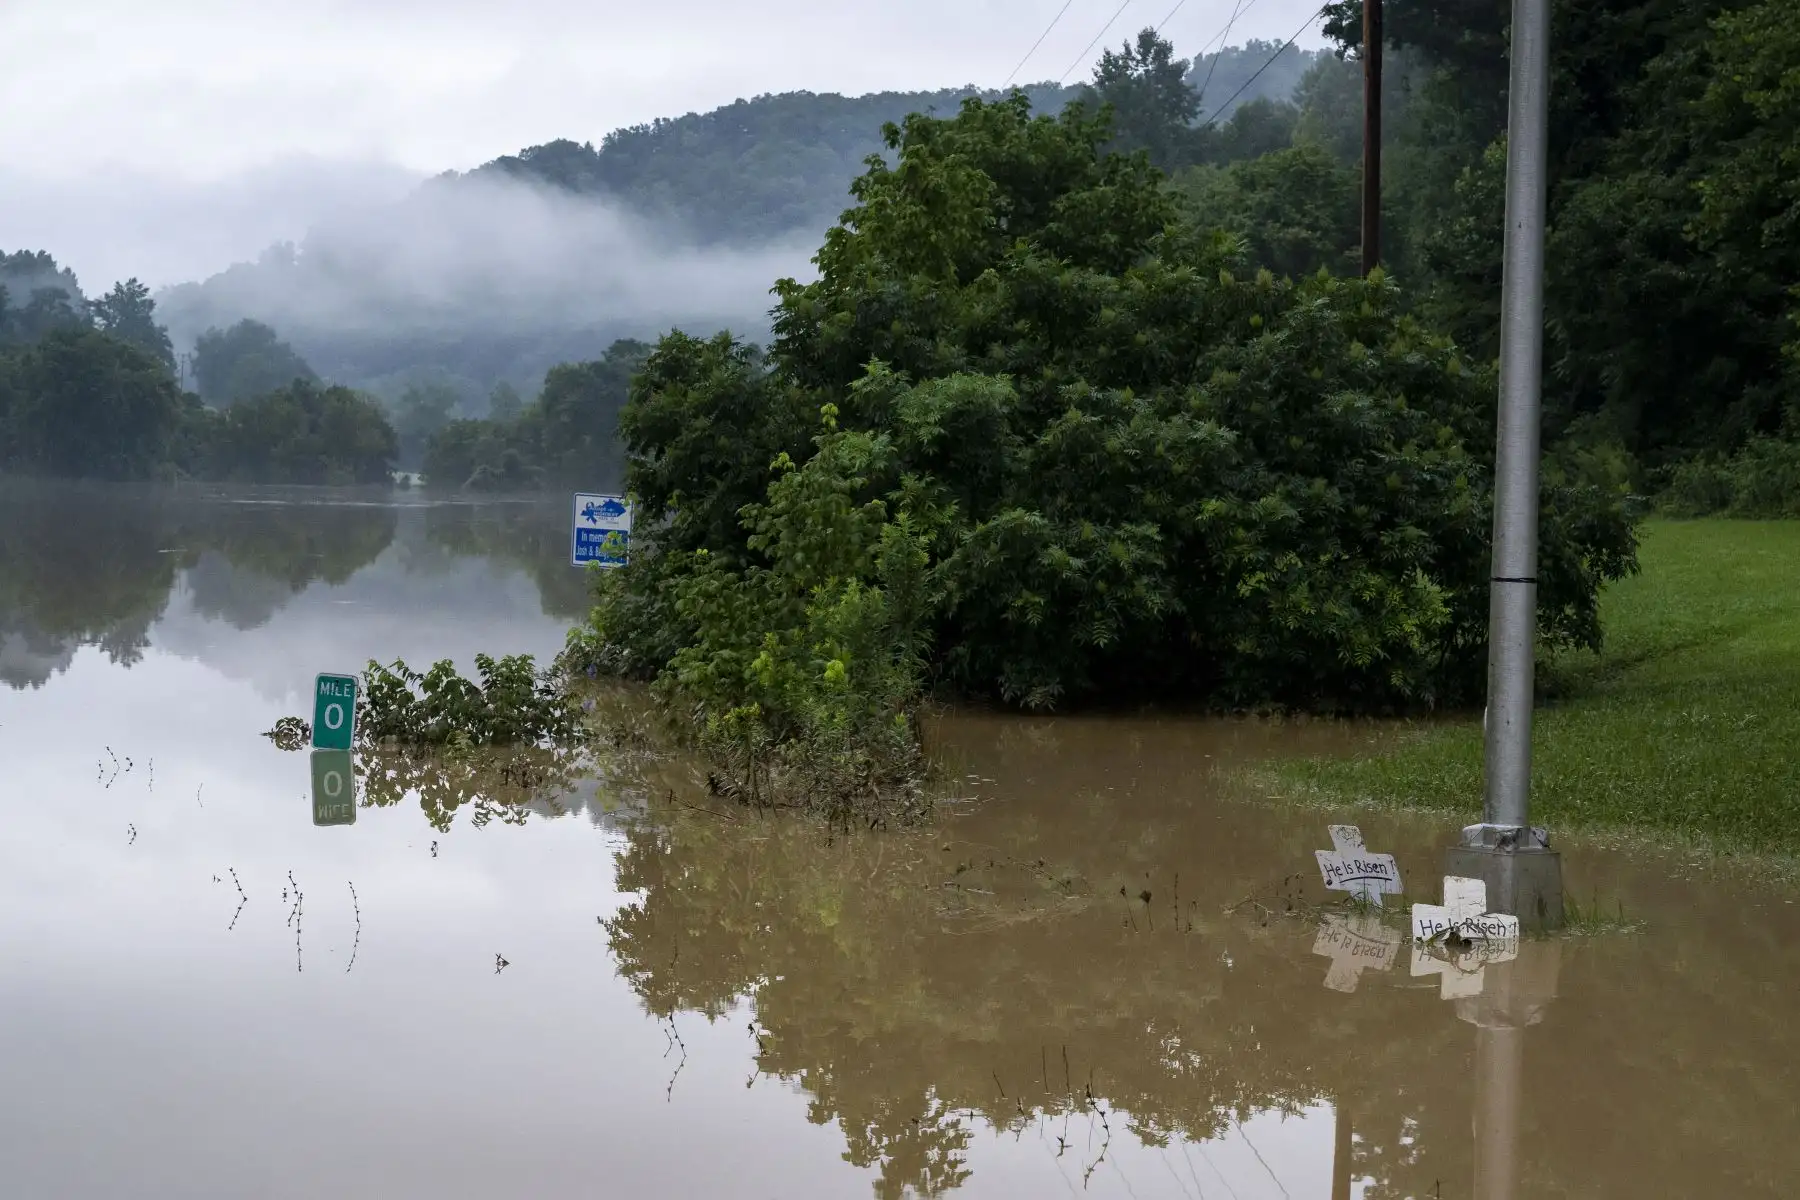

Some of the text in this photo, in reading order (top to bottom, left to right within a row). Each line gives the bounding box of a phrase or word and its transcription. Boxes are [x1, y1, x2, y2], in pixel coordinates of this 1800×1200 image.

[581, 531, 588, 542] In
[319, 681, 352, 698] MILE
[324, 703, 344, 730] 0
[1323, 863, 1343, 879] He
[1342, 861, 1354, 875] Is
[1419, 919, 1443, 936] He
[1447, 917, 1460, 931] Is
